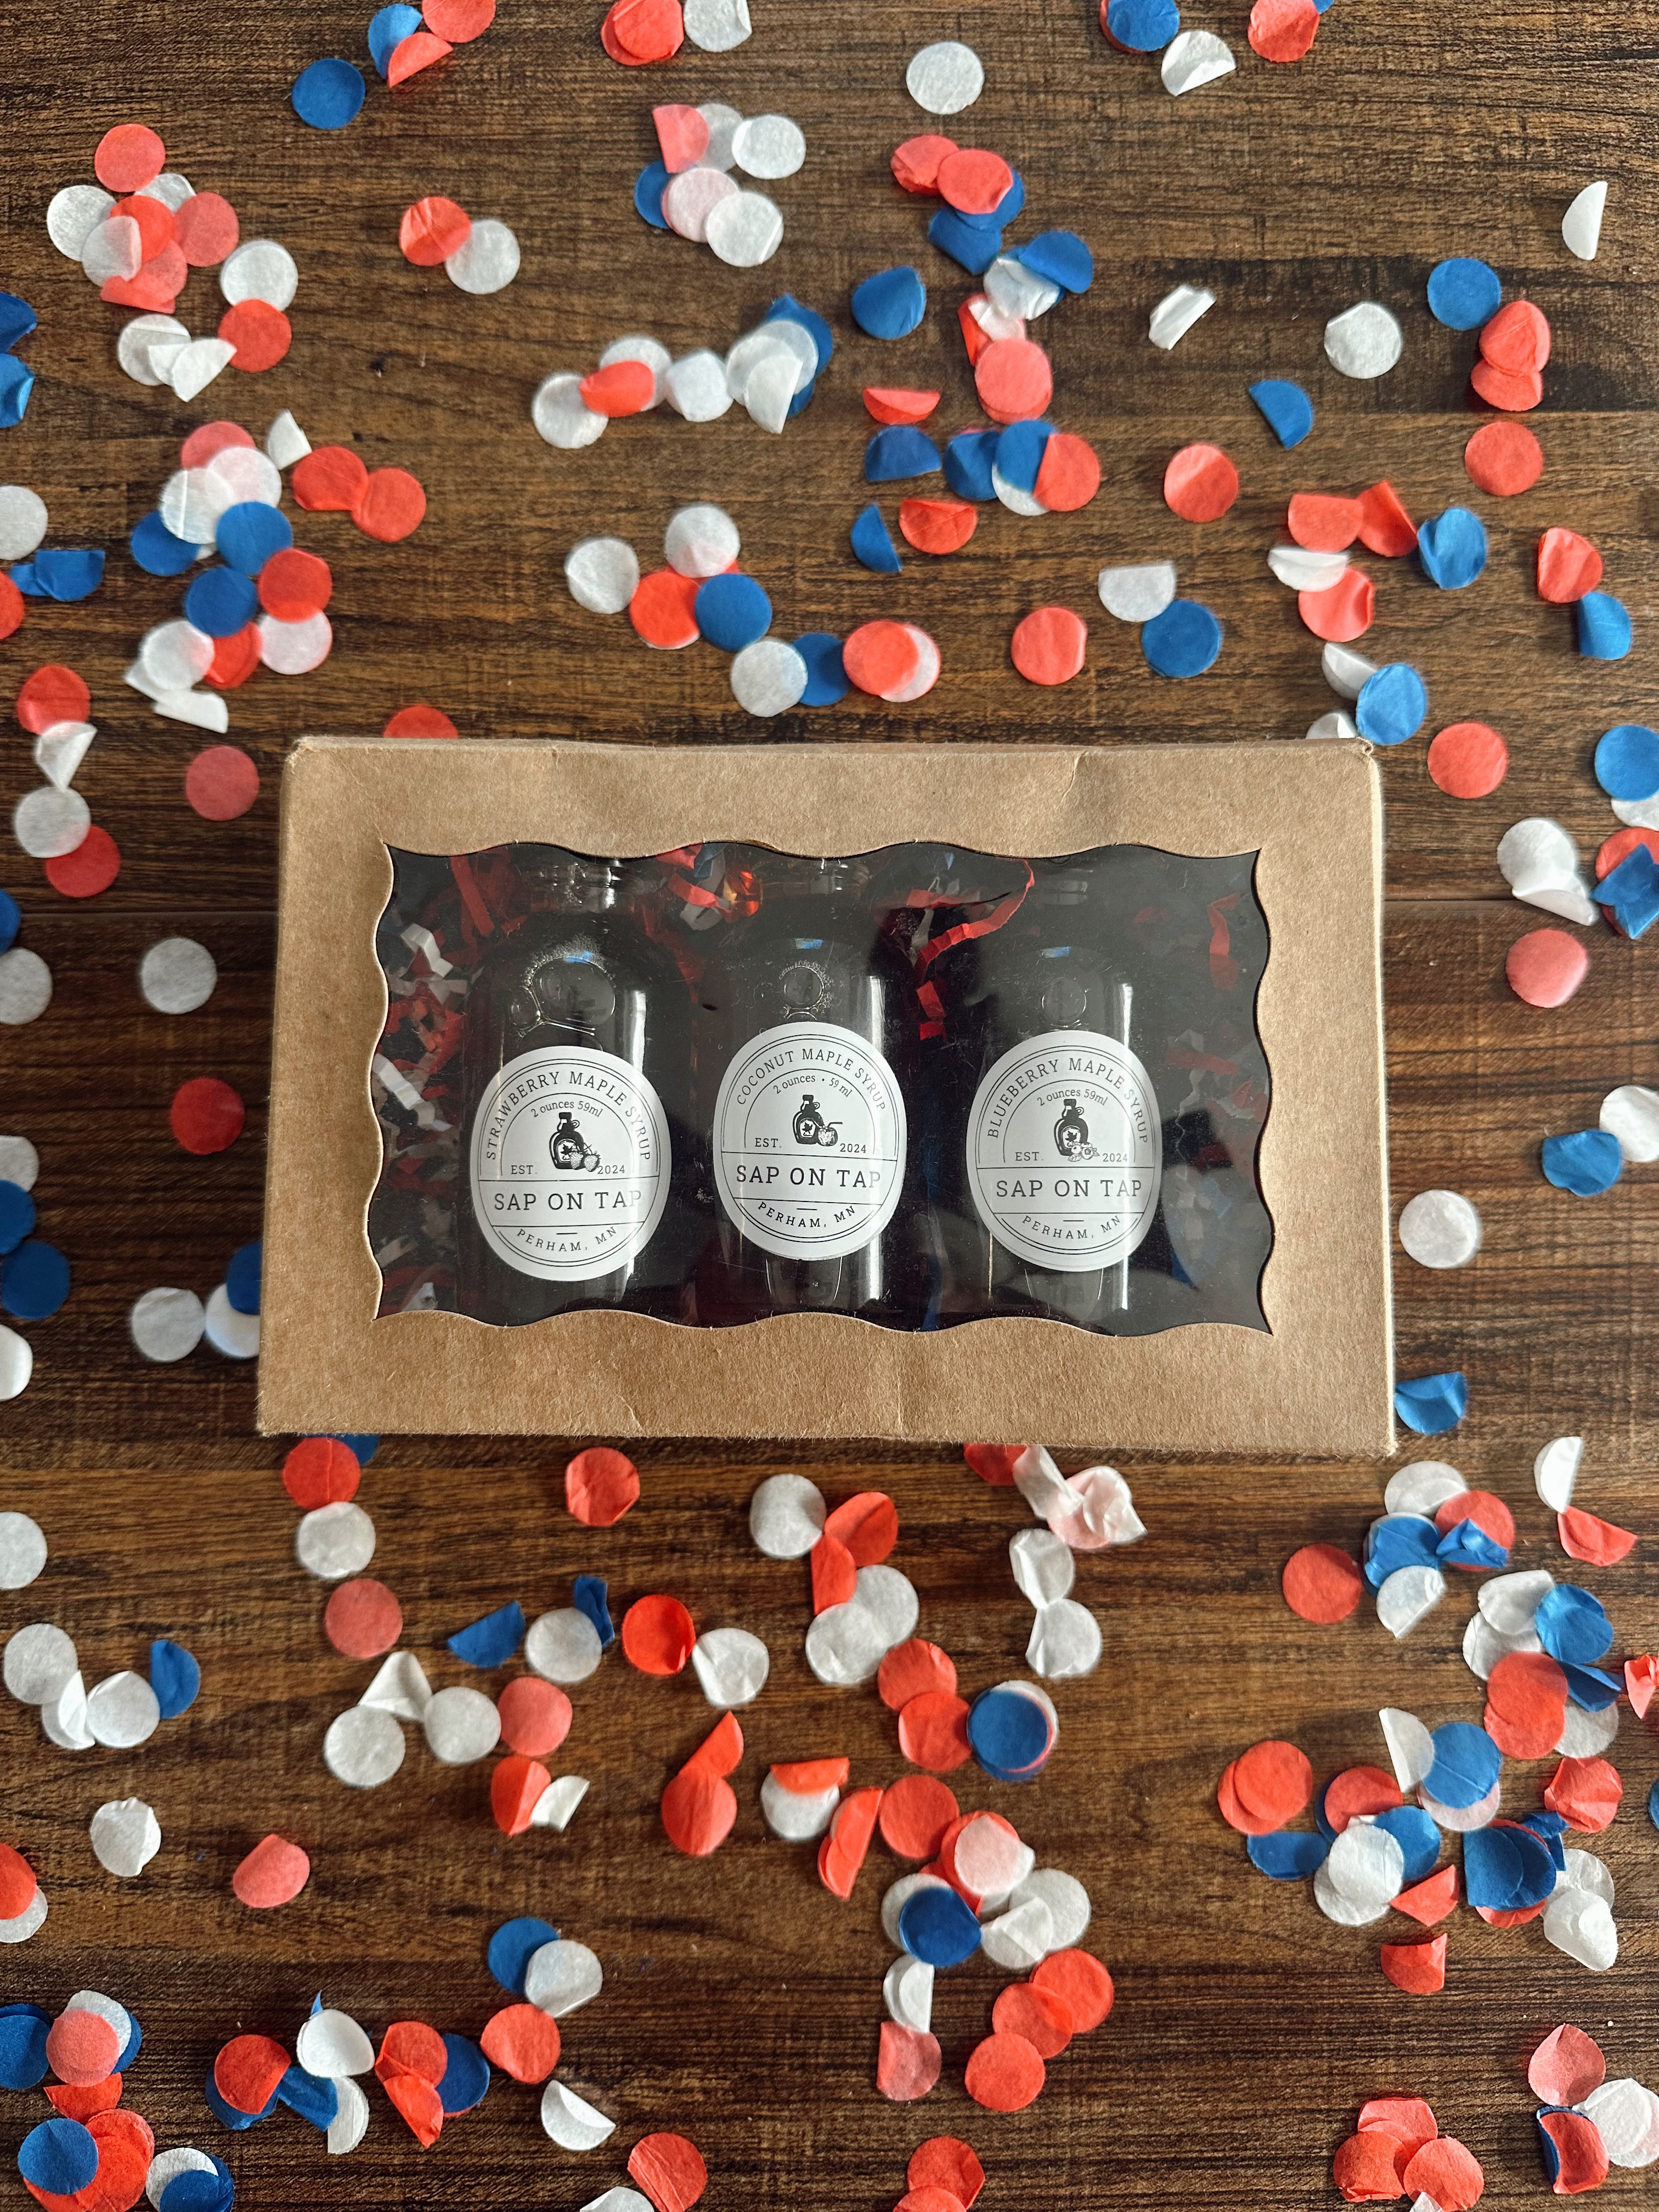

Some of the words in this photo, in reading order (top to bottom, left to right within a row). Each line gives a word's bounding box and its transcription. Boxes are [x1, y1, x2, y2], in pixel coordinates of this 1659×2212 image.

[737, 1051, 794, 1104] COCONUT
[802, 1048, 854, 1070] MAPLE
[855, 1068, 886, 1110] SYRUP
[773, 1086, 781, 1094] 2
[782, 1075, 816, 1089] ounces
[829, 1077, 839, 1088] 59
[839, 1085, 853, 1097] ml
[988, 1059, 1059, 1138] BLUEBERRY
[1069, 1058, 1125, 1089] MAPLE
[1125, 1089, 1147, 1143] SYRUP
[1037, 1097, 1045, 1106] 2
[1046, 1088, 1081, 1102] ounces
[1084, 1089, 1108, 1106] 59ml
[487, 1071, 560, 1160] STRAWBERRY
[569, 1071, 627, 1106] MAPLE
[625, 1106, 651, 1160] SYRUP
[531, 1109, 538, 1118] 2
[540, 1100, 574, 1113] ounces
[578, 1101, 603, 1118] 59ml
[755, 1138, 781, 1148] EST.
[840, 1143, 866, 1153] 2024
[1015, 1152, 1043, 1161] EST.
[1103, 1153, 1128, 1162] 2024
[511, 1165, 538, 1175] EST.
[597, 1165, 625, 1174] 2024
[737, 1165, 780, 1183] SAP
[791, 1167, 826, 1186] ON
[837, 1170, 881, 1188] TAP
[996, 1180, 1042, 1197] SAP
[1055, 1180, 1090, 1197] ON
[1101, 1180, 1141, 1197] TAP
[495, 1193, 537, 1210] SAP
[548, 1193, 584, 1210] ON
[595, 1190, 641, 1208] TAP
[758, 1201, 826, 1227] PERHAM,
[834, 1206, 856, 1222] MN
[1022, 1215, 1094, 1239] PERHAM,
[1101, 1215, 1121, 1233] MN
[517, 1229, 588, 1251] PERHAM,
[595, 1226, 617, 1244] MN
